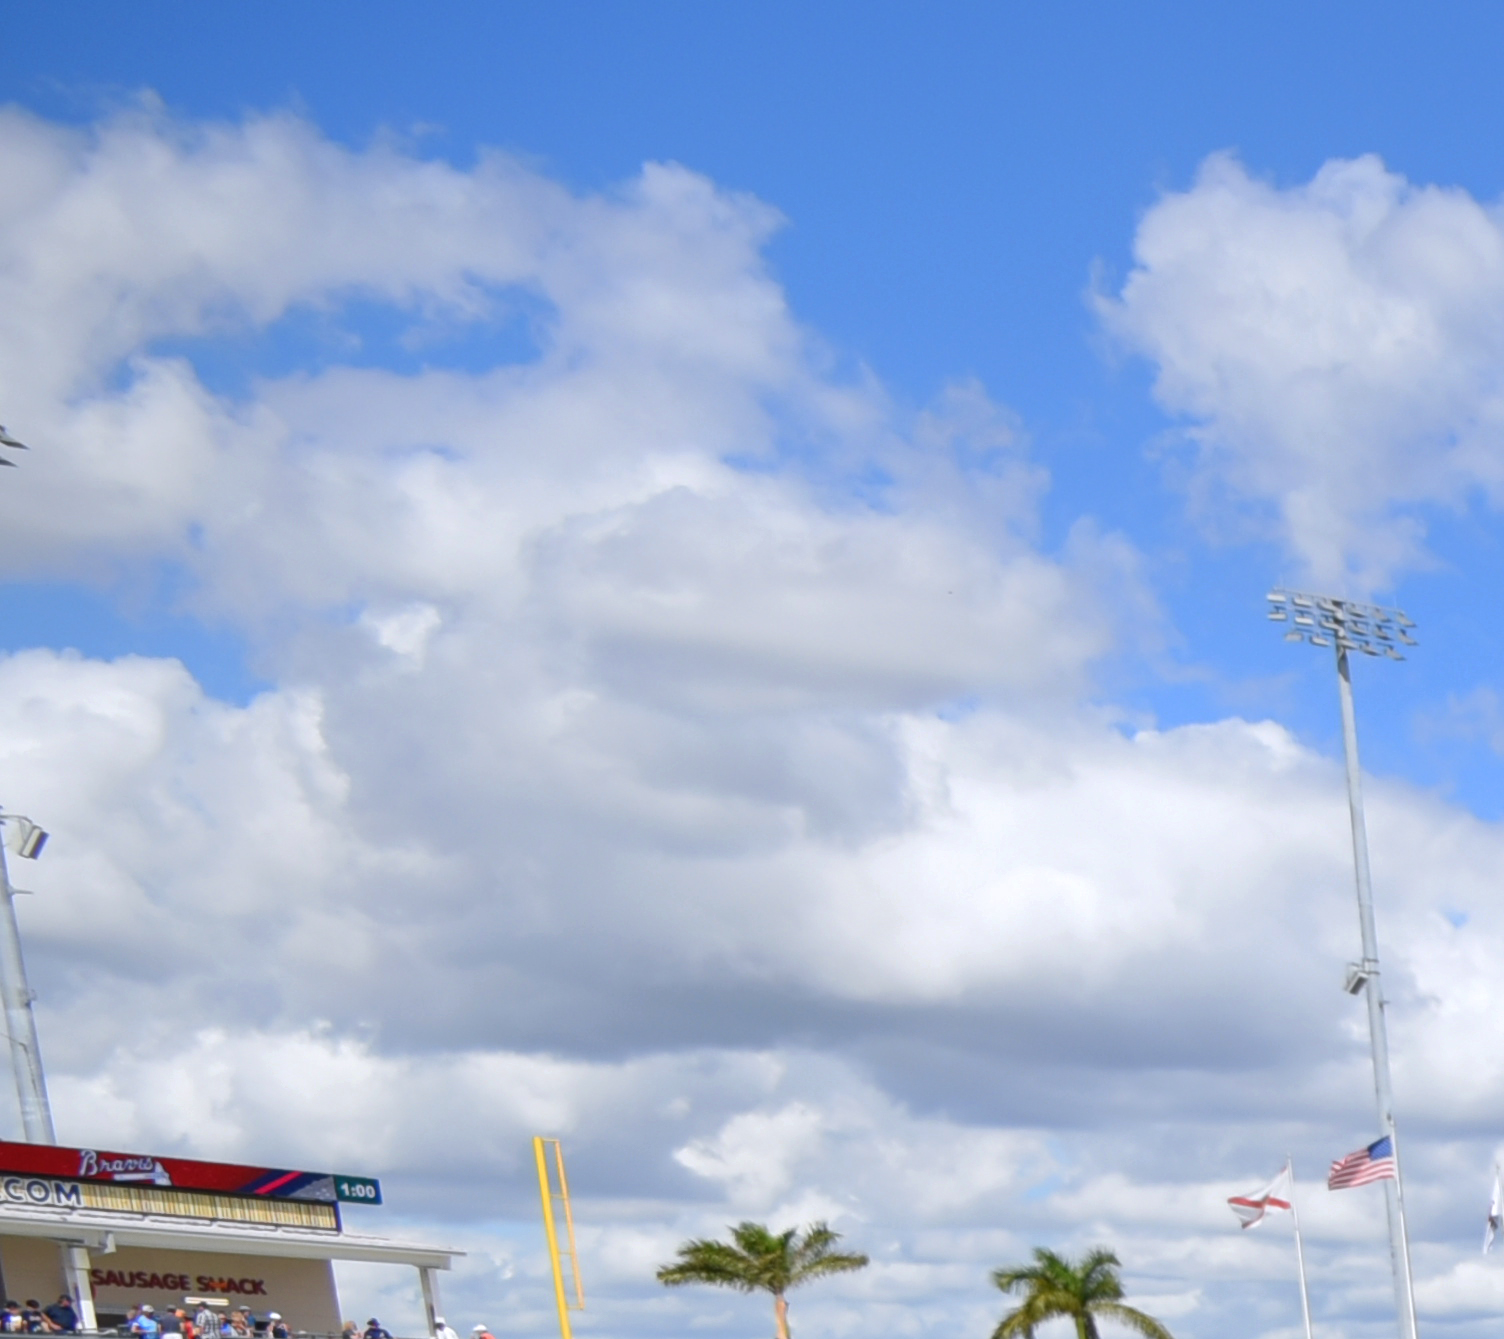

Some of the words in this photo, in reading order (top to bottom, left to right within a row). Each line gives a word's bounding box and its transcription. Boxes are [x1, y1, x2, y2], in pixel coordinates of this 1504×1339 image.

[79, 1149, 155, 1176] Braves
[340, 1182, 376, 1199] 1:00
[91, 1269, 190, 1291] SAUSAGE
[196, 1275, 267, 1296] SHACK
